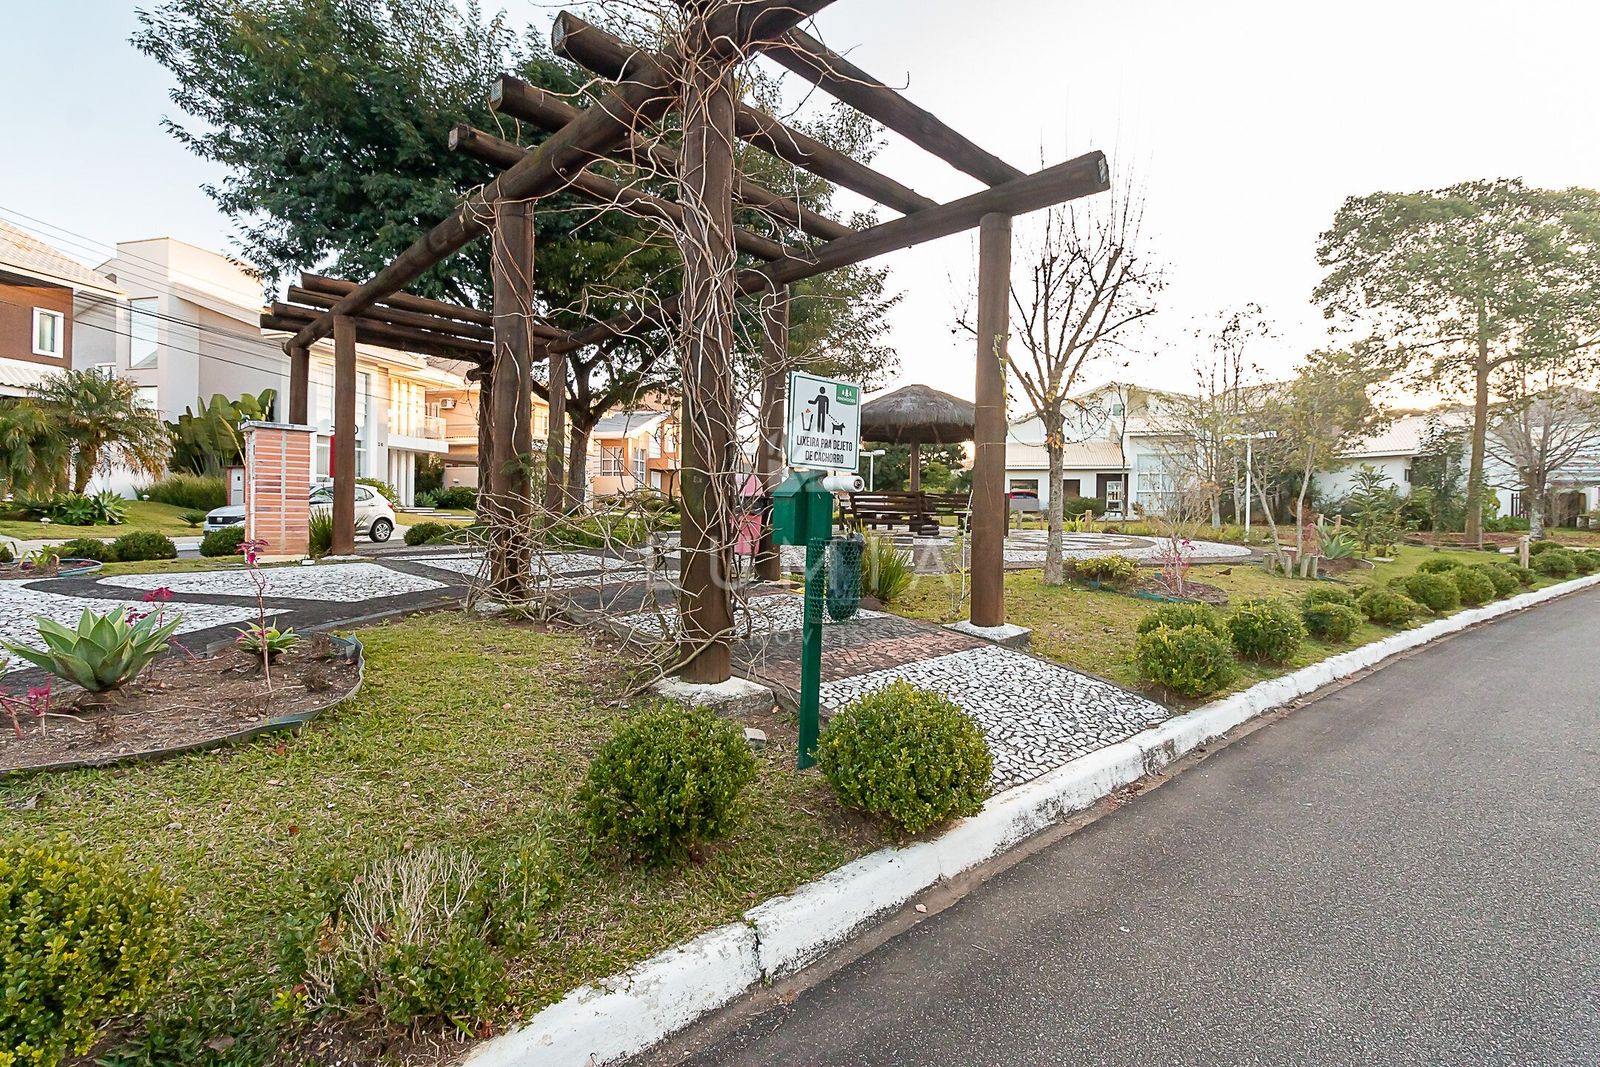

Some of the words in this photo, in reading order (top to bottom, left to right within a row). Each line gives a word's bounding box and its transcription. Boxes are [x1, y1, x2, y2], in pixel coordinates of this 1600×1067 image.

[796, 435, 819, 447] LIXEIRA
[820, 438, 831, 448] PRA
[833, 440, 852, 451] DEJETO
[805, 450, 813, 460] DE
[814, 451, 844, 464] CACHORRO
